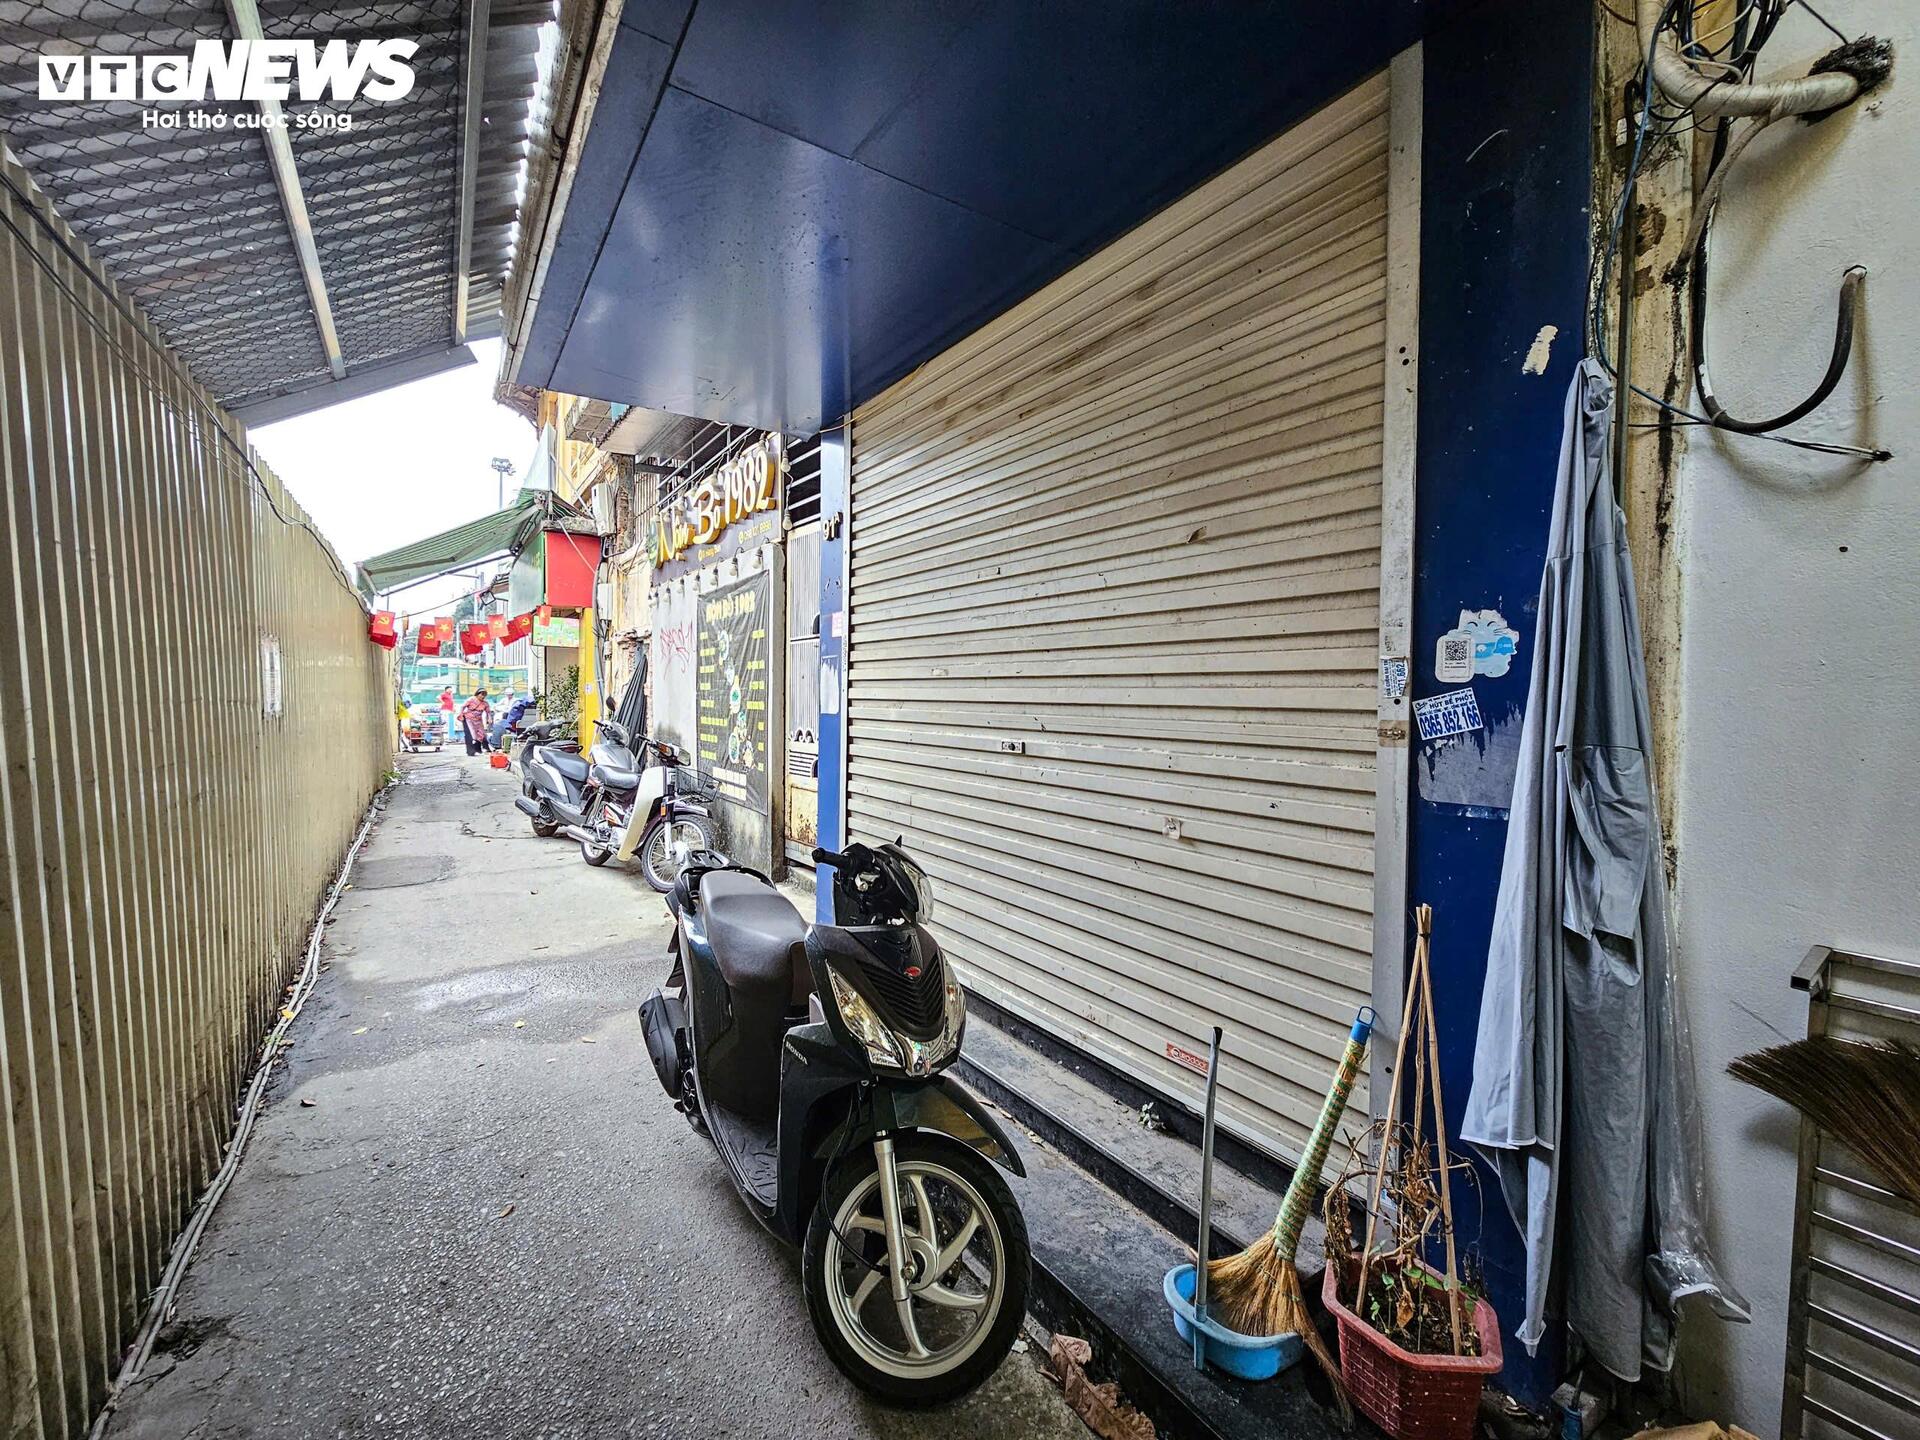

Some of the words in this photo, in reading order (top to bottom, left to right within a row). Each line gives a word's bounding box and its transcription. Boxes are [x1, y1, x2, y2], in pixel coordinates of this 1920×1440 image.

[718, 449, 772, 525] 1982
[1419, 705, 1482, 738] 0365.852.166
[785, 1041, 808, 1065] HONDA
